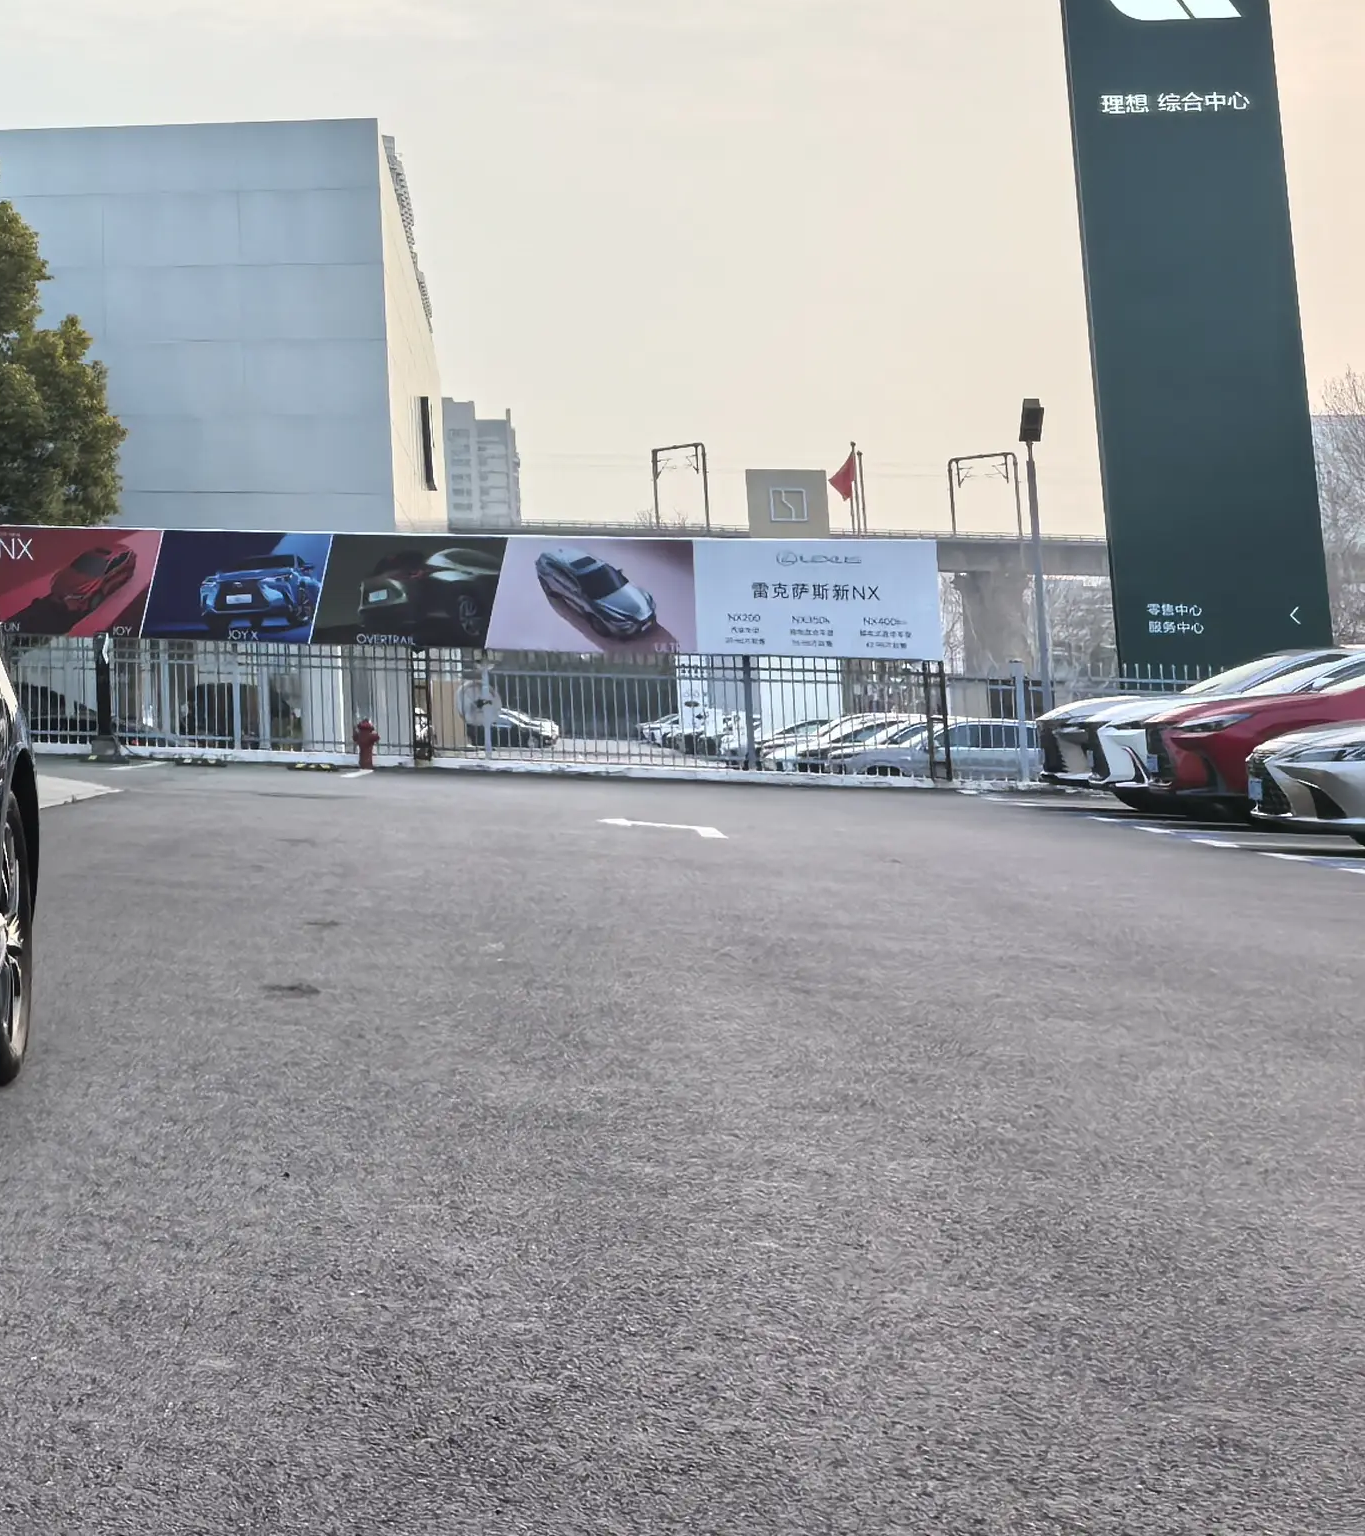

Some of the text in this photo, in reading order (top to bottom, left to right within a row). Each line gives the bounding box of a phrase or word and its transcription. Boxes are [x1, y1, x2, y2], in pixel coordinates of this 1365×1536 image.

[1100, 91, 1251, 114] 理想 综合中心
[751, 582, 881, 601] 雷克萨斯新NX
[1147, 603, 1202, 616] 零售中心
[1149, 621, 1204, 634] 服务中心
[227, 629, 259, 641] JOY X
[356, 633, 416, 646] OVERTRAIL
